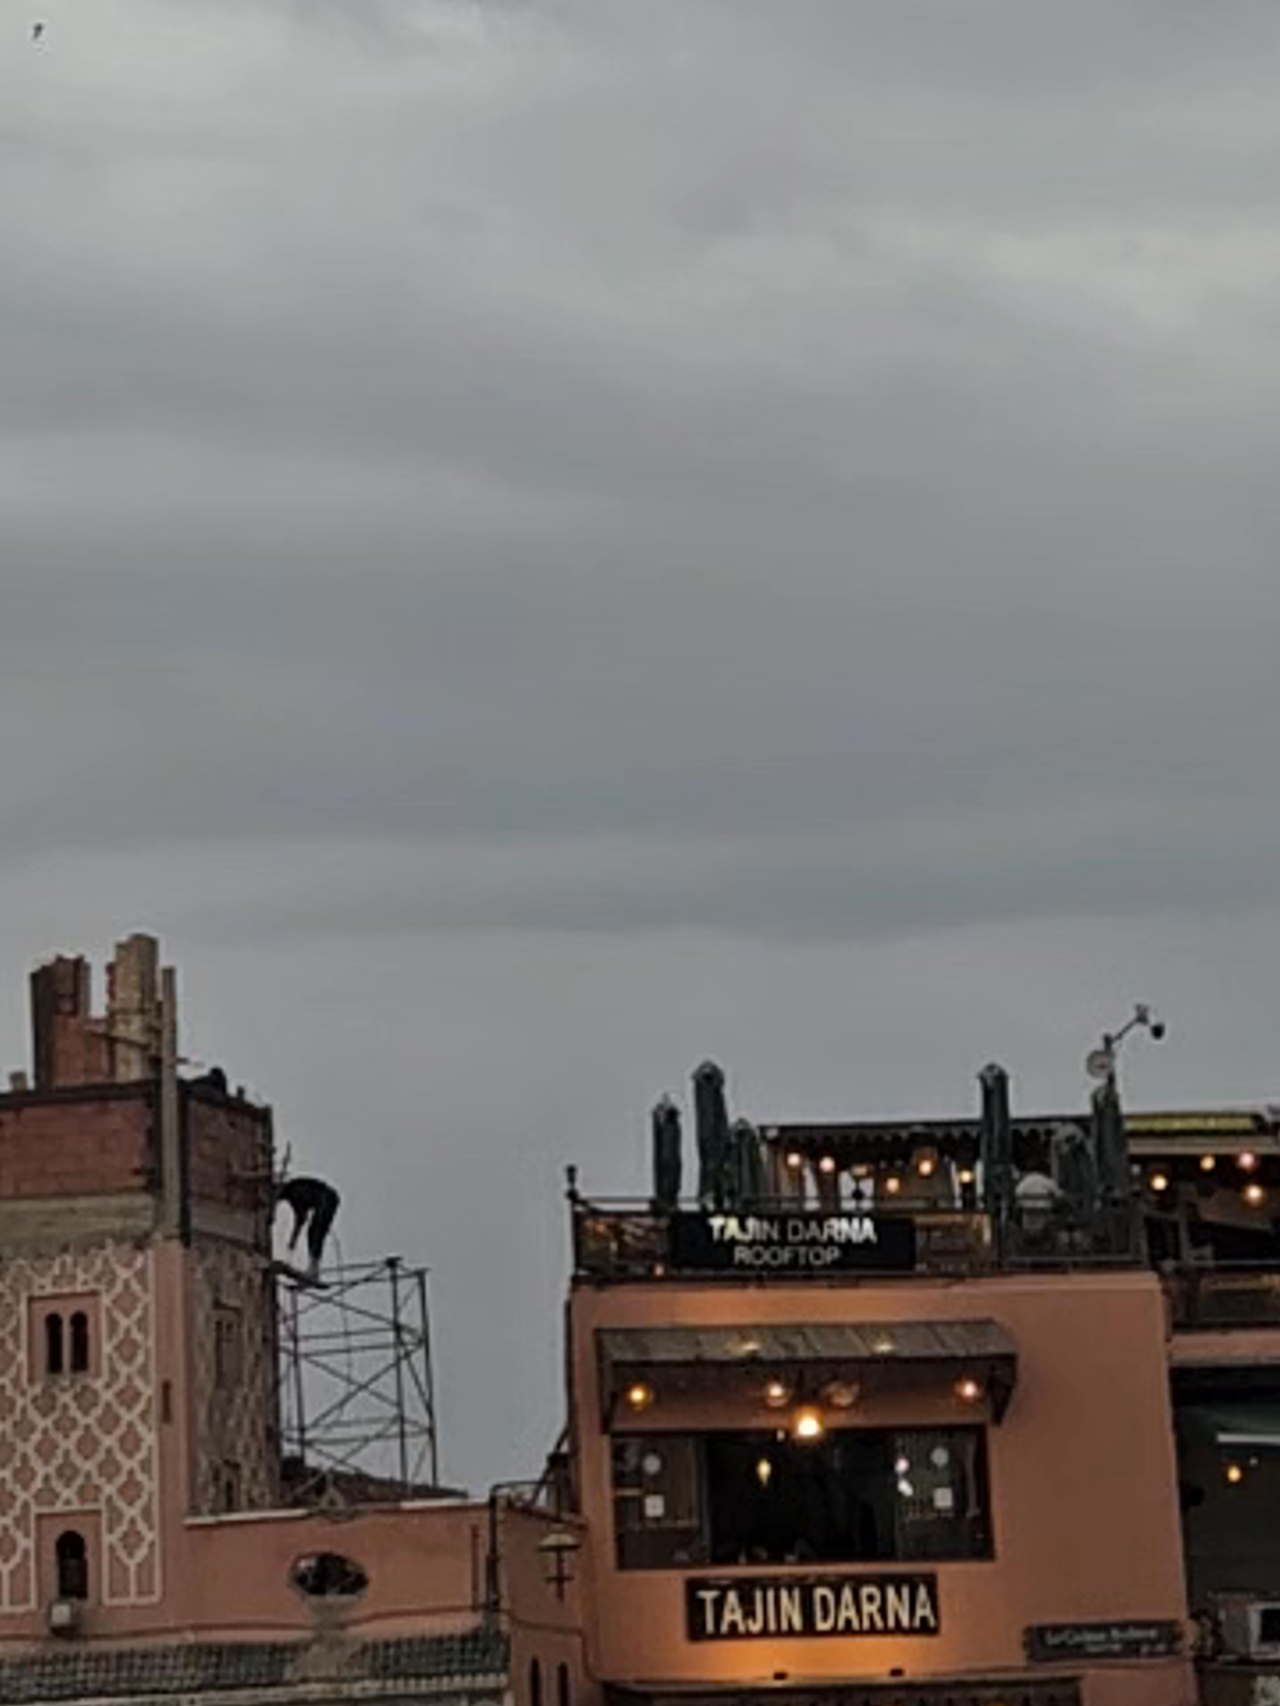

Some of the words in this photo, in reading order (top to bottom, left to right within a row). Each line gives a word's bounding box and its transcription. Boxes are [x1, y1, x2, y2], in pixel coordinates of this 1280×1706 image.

[707, 1215, 780, 1244] TAJIN
[786, 1215, 880, 1244] DARNA
[733, 1244, 842, 1266] ROOFTOP
[695, 1585, 804, 1636] TAJIN
[812, 1582, 938, 1633] DARNA
